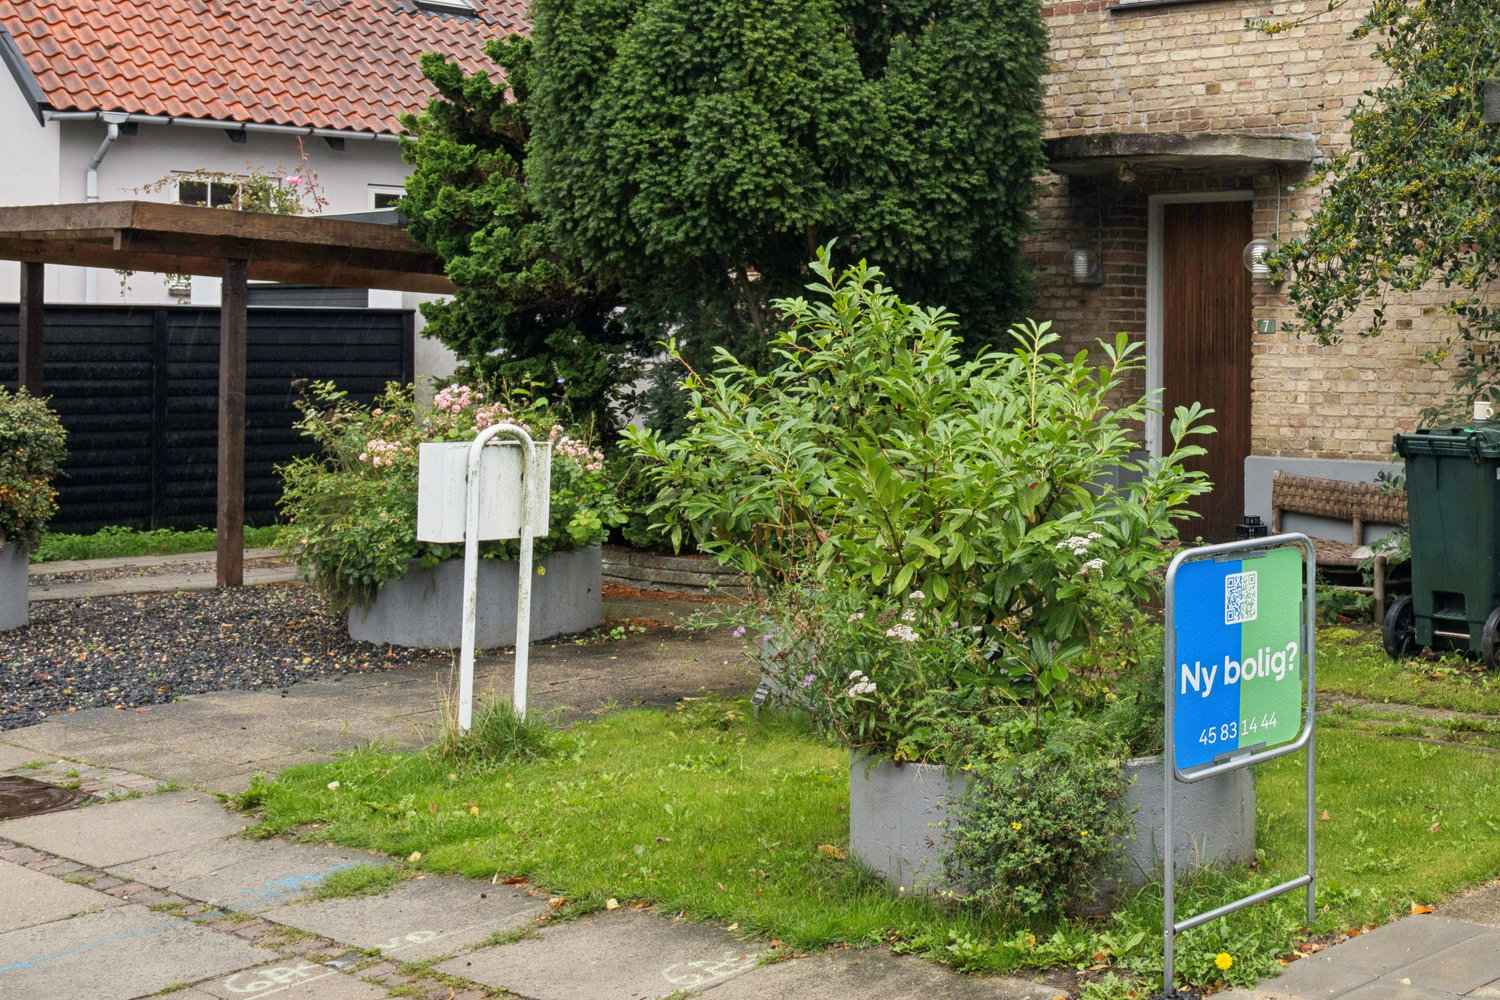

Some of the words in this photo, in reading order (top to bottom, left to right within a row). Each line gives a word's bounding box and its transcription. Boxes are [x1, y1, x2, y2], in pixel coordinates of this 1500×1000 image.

[1263, 320, 1269, 333] 7
[1181, 661, 1218, 698] Ny
[1224, 641, 1298, 685] bolig?
[1199, 726, 1217, 745] 45
[1220, 722, 1237, 741] 83
[1241, 716, 1257, 736] 14
[1261, 712, 1277, 730] 44
